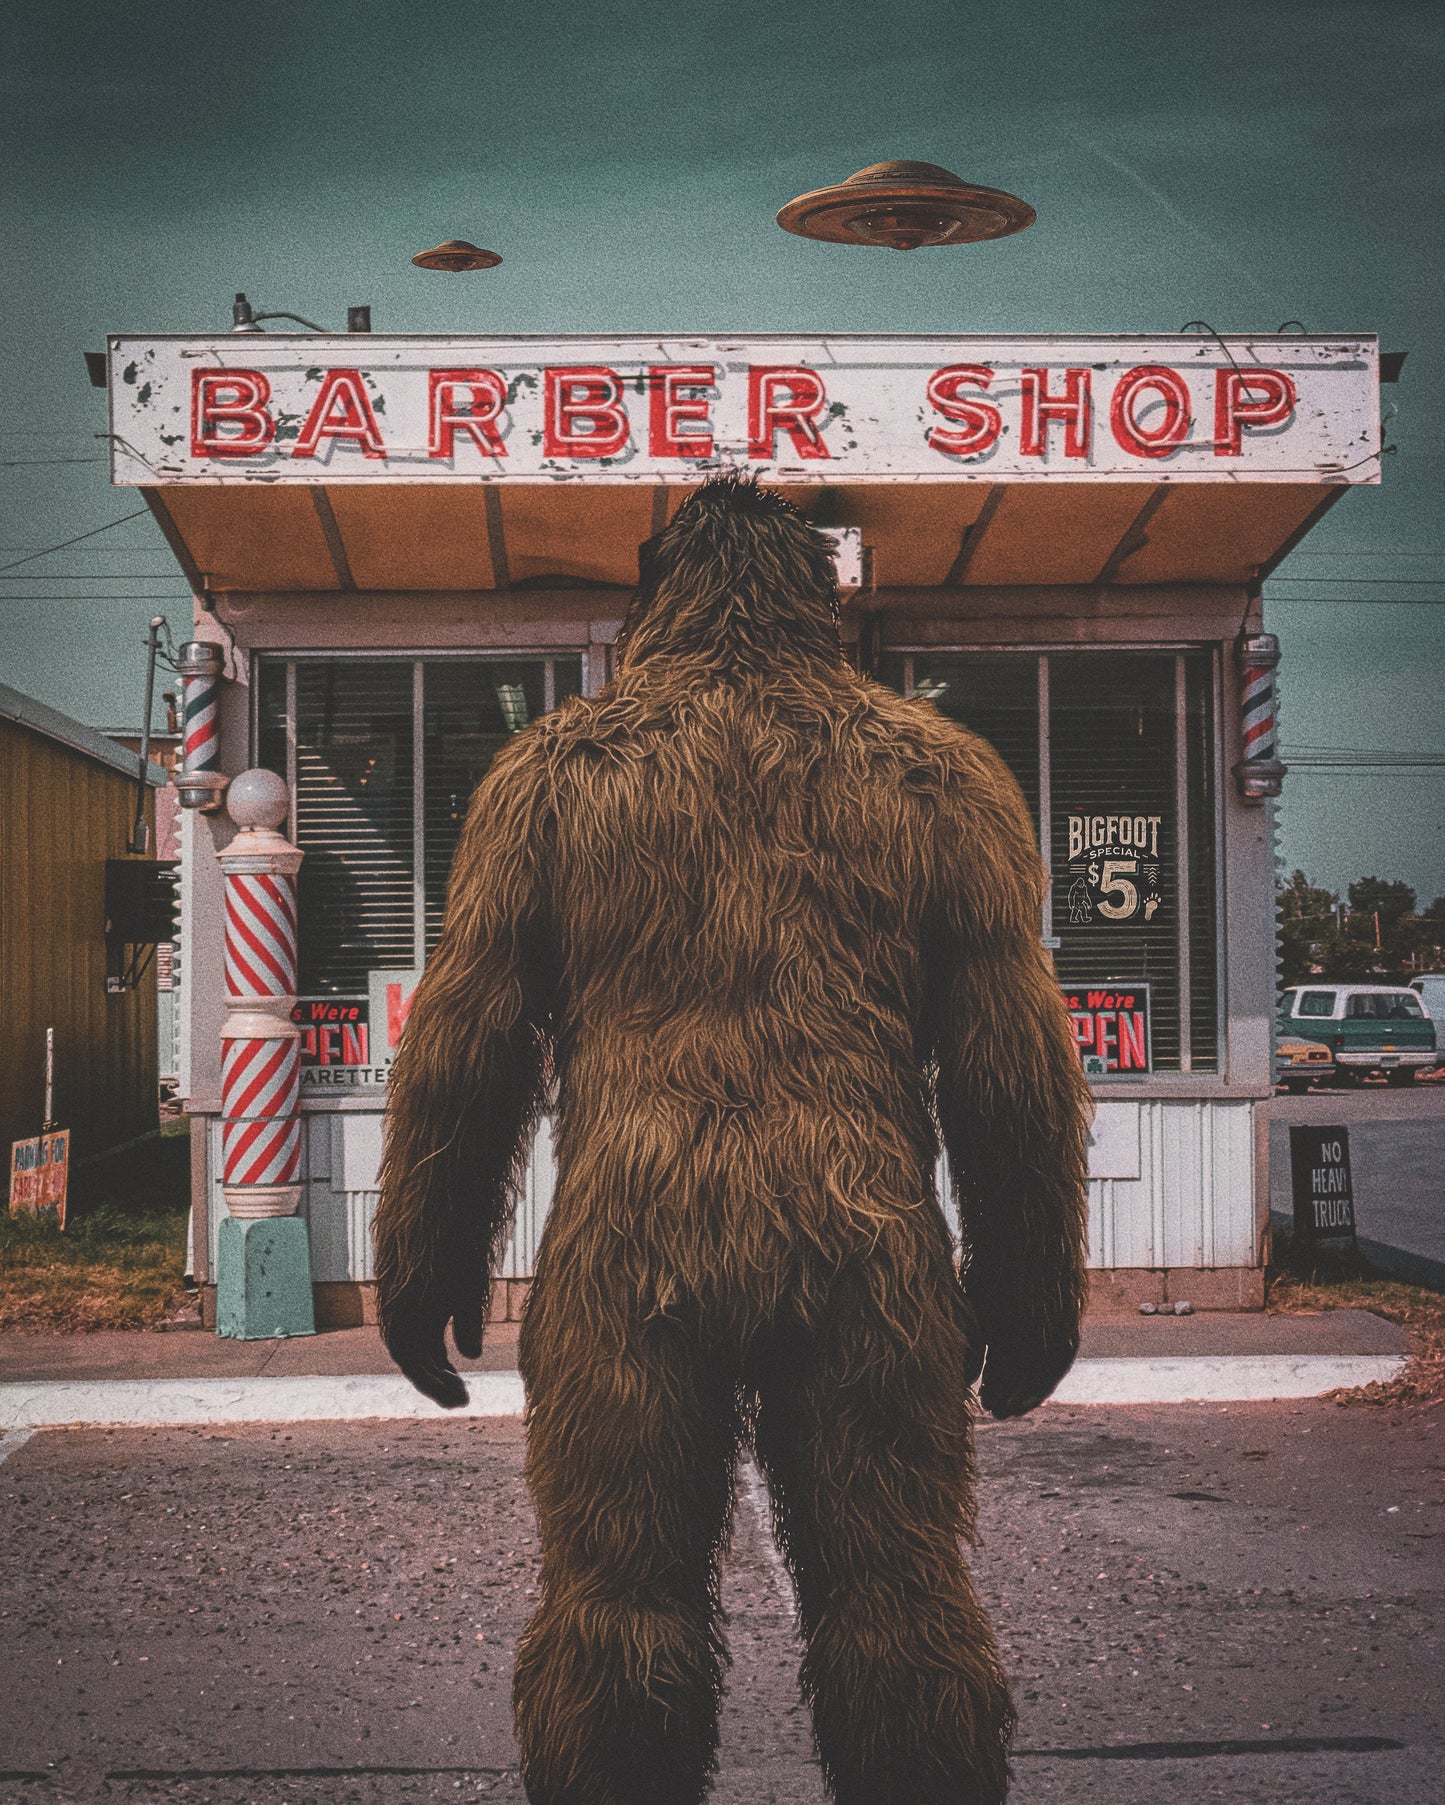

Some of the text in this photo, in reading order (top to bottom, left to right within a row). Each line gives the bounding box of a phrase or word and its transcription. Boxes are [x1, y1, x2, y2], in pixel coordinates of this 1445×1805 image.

[190, 363, 1297, 460] BARBER SHOP
[1067, 815, 1162, 861] BIGFOOT
[1089, 846, 1141, 859] SPECIAL
[1087, 860, 1139, 919] $5
[311, 1003, 360, 1020] We're
[1087, 990, 1135, 1009] We're
[299, 1022, 368, 1066] PEN
[1068, 1011, 1146, 1068] PEN
[1321, 1141, 1342, 1163] NO
